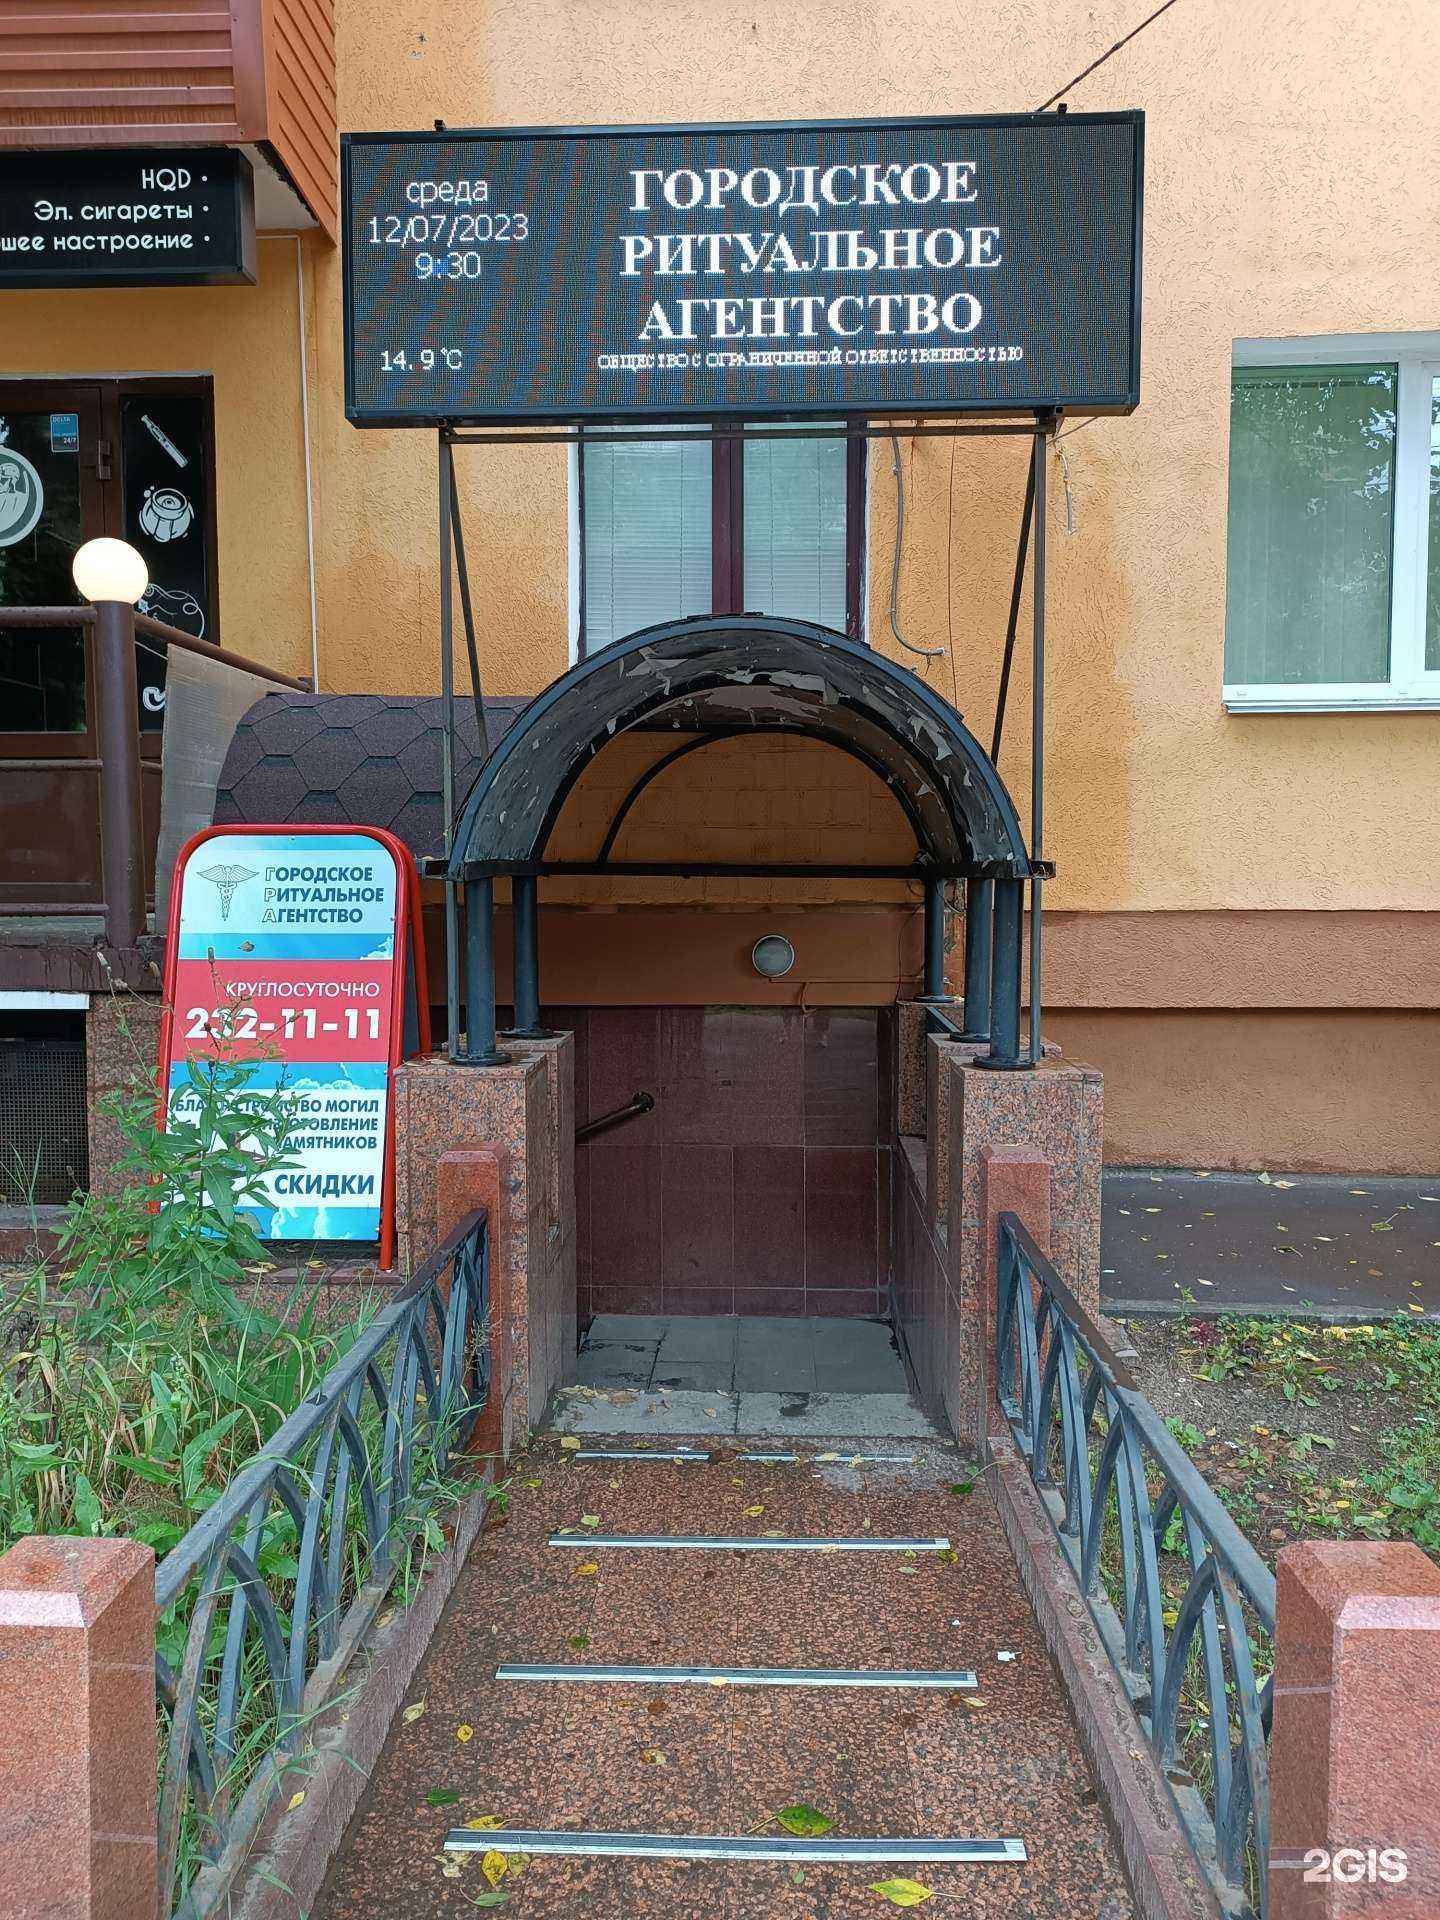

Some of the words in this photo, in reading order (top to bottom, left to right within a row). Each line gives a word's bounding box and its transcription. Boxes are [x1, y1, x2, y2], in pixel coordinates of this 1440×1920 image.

[142, 168, 191, 191] HQD
[629, 161, 978, 219] ГОРОДСКОЕ
[406, 180, 488, 208] среда
[34, 201, 74, 221] Эл.
[81, 204, 193, 223] сигареты
[369, 213, 529, 249] 12/07/2023
[53, 234, 194, 253] настроение
[619, 226, 1002, 277] РИТУАЛЬНОЕ
[415, 251, 481, 280] 9:30
[638, 292, 984, 341] АГЕНТСТВО
[598, 352, 689, 373] ОБЩЕСТВО
[706, 345, 842, 368] ОГРАНИЧЕННОЙ
[846, 346, 1023, 364] ОТВЕТСТВЕННОСТЬЮ
[265, 866, 373, 883] ГОРОДСКОЕ
[264, 887, 385, 903] РИТУАЛЬНОЕ
[262, 908, 364, 924] АГЕНТСТВО
[226, 982, 381, 998] КРУГЛОСУТОЧНО
[184, 1007, 380, 1040] 232-11-11
[325, 1099, 379, 1113] МОГИЛ
[278, 1136, 378, 1149] АМЯТНИКОВ
[274, 1174, 375, 1198] СКИДКИ
